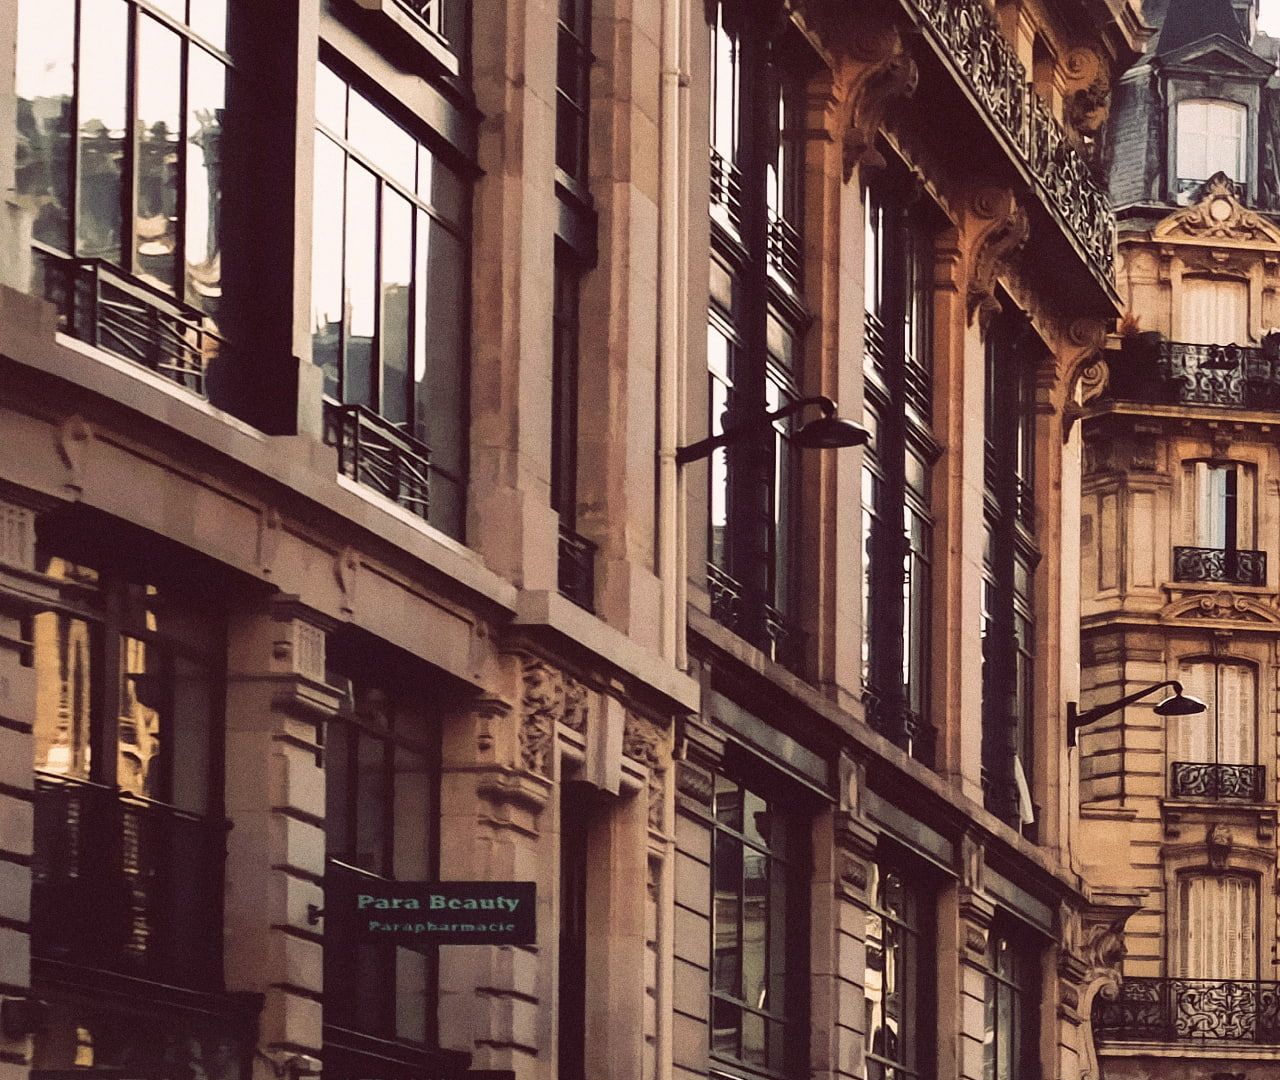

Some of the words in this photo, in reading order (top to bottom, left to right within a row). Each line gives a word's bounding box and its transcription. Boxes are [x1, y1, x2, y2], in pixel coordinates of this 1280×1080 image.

[357, 894, 420, 910] Para
[429, 894, 520, 912] Beauty
[368, 920, 515, 934] Parapharmacie
